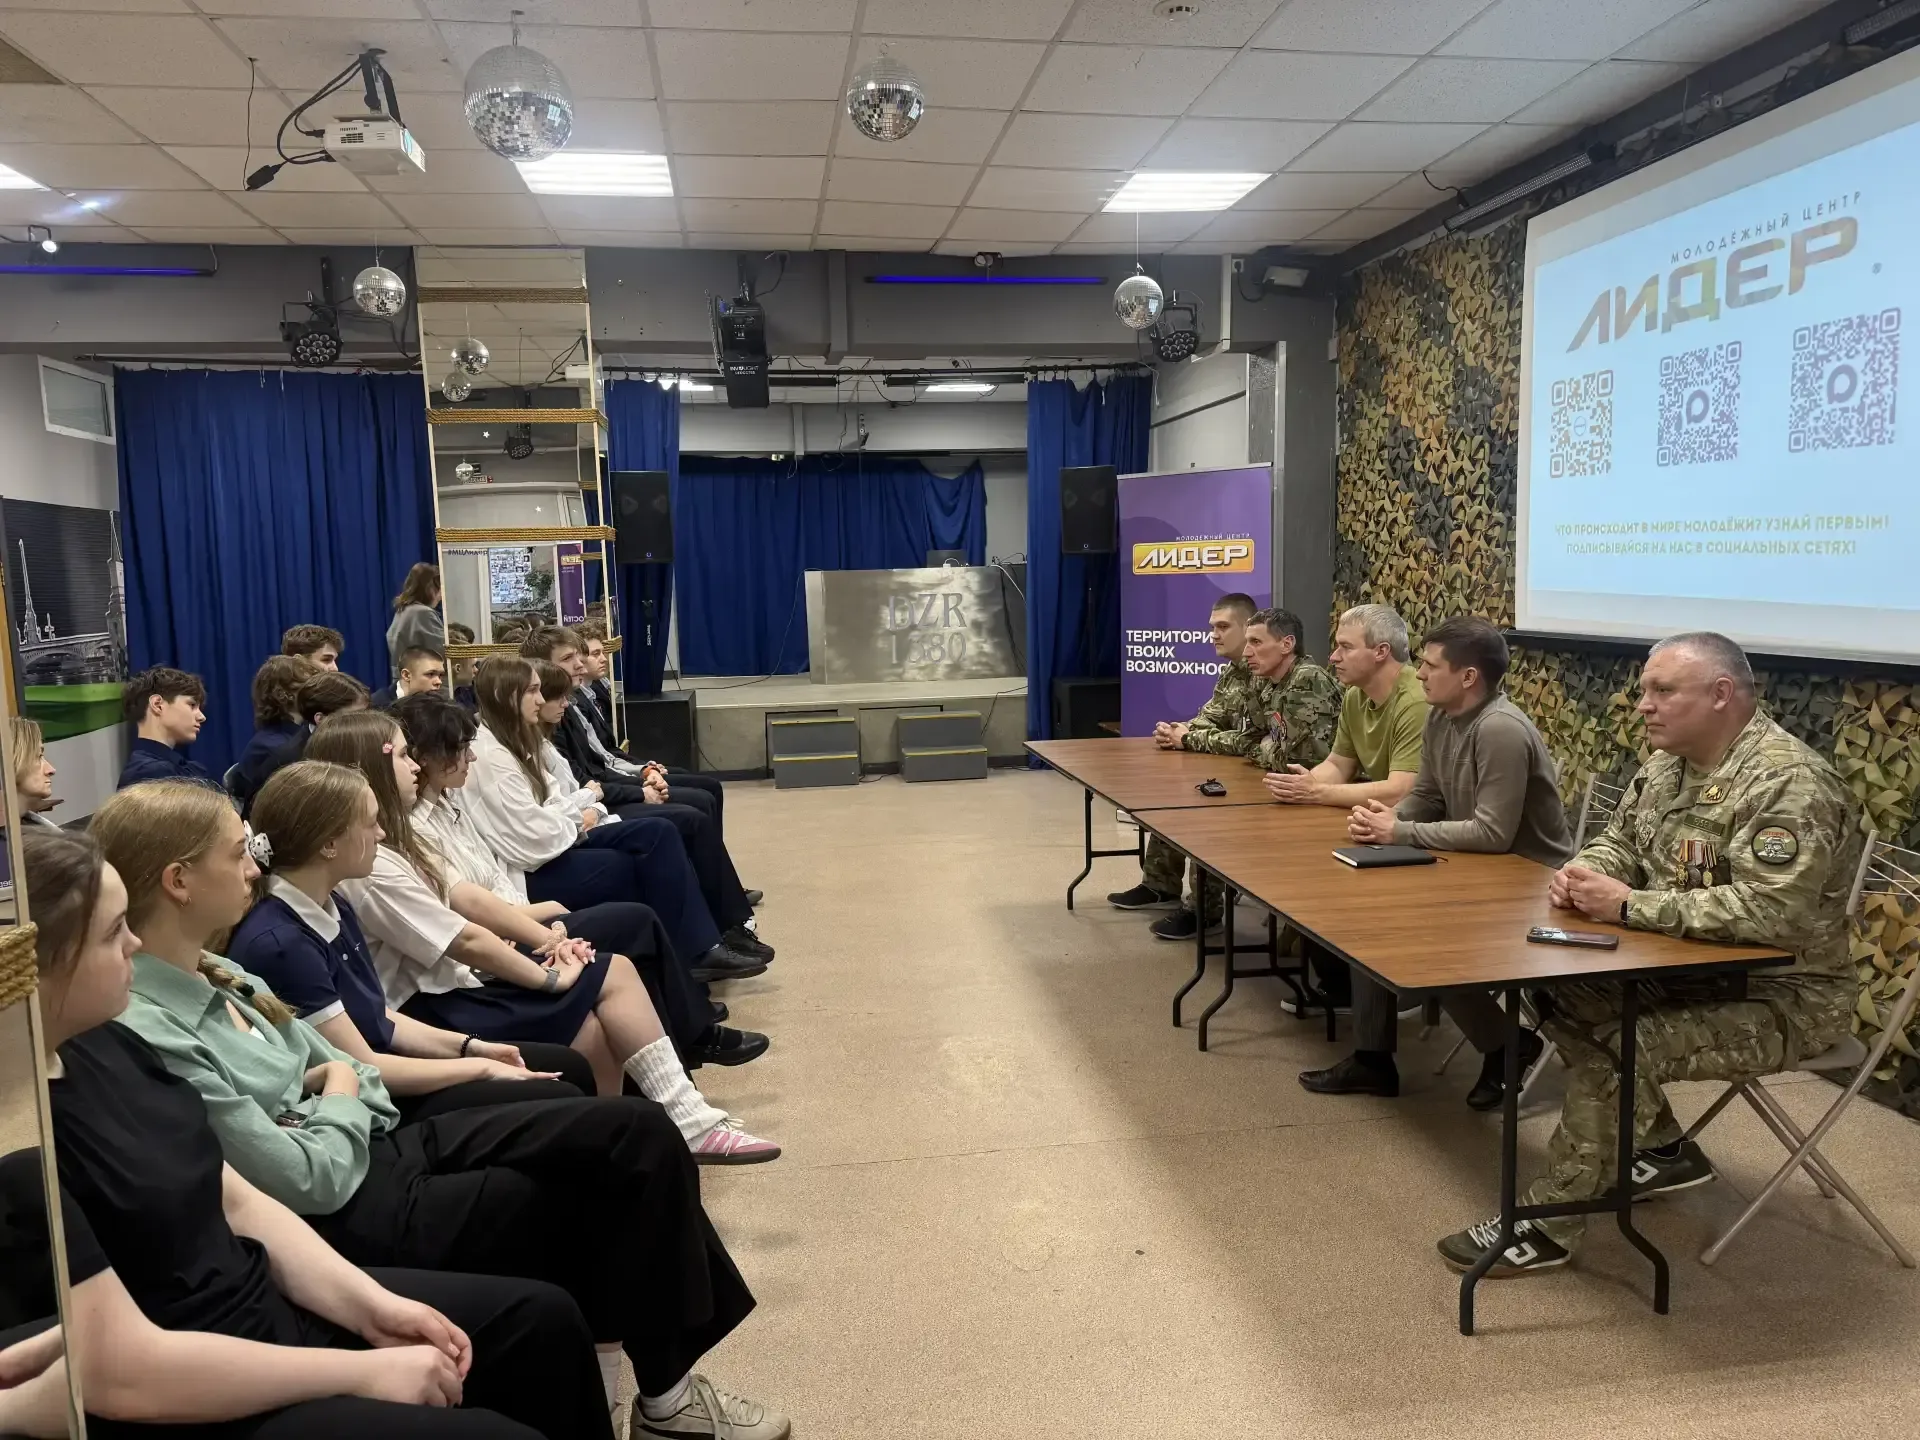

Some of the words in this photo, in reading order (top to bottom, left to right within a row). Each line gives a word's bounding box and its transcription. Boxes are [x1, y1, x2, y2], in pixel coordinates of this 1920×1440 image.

[1803, 191, 1861, 221] ЦЕНТР
[1566, 216, 1858, 352] ЛИДЕР
[1226, 532, 1250, 540] ЦЕНТР
[1555, 523, 1572, 536] ЧТО
[1574, 523, 1639, 536] ПРОИСХОДИТ
[1641, 522, 1648, 533] В
[1651, 520, 1680, 533] МИРЕ
[1683, 516, 1761, 533] МОЛОДЁЖИ?
[1765, 514, 1811, 532] УЗНАЙ
[1815, 514, 1889, 531] ПЕРВЫМ!
[1137, 545, 1249, 568] ЛИДЕР
[1566, 539, 1650, 555] ПОДПИСЫВАЙСЯ
[1651, 541, 1666, 554] НА
[1669, 541, 1693, 554] НАС
[1696, 542, 1703, 554] В
[1705, 540, 1800, 555] СОЦИАЛЬНЫХ
[1804, 540, 1857, 555] СЕТЯХ!
[889, 593, 967, 630] DZR
[1125, 645, 1175, 658] ТВОИХ
